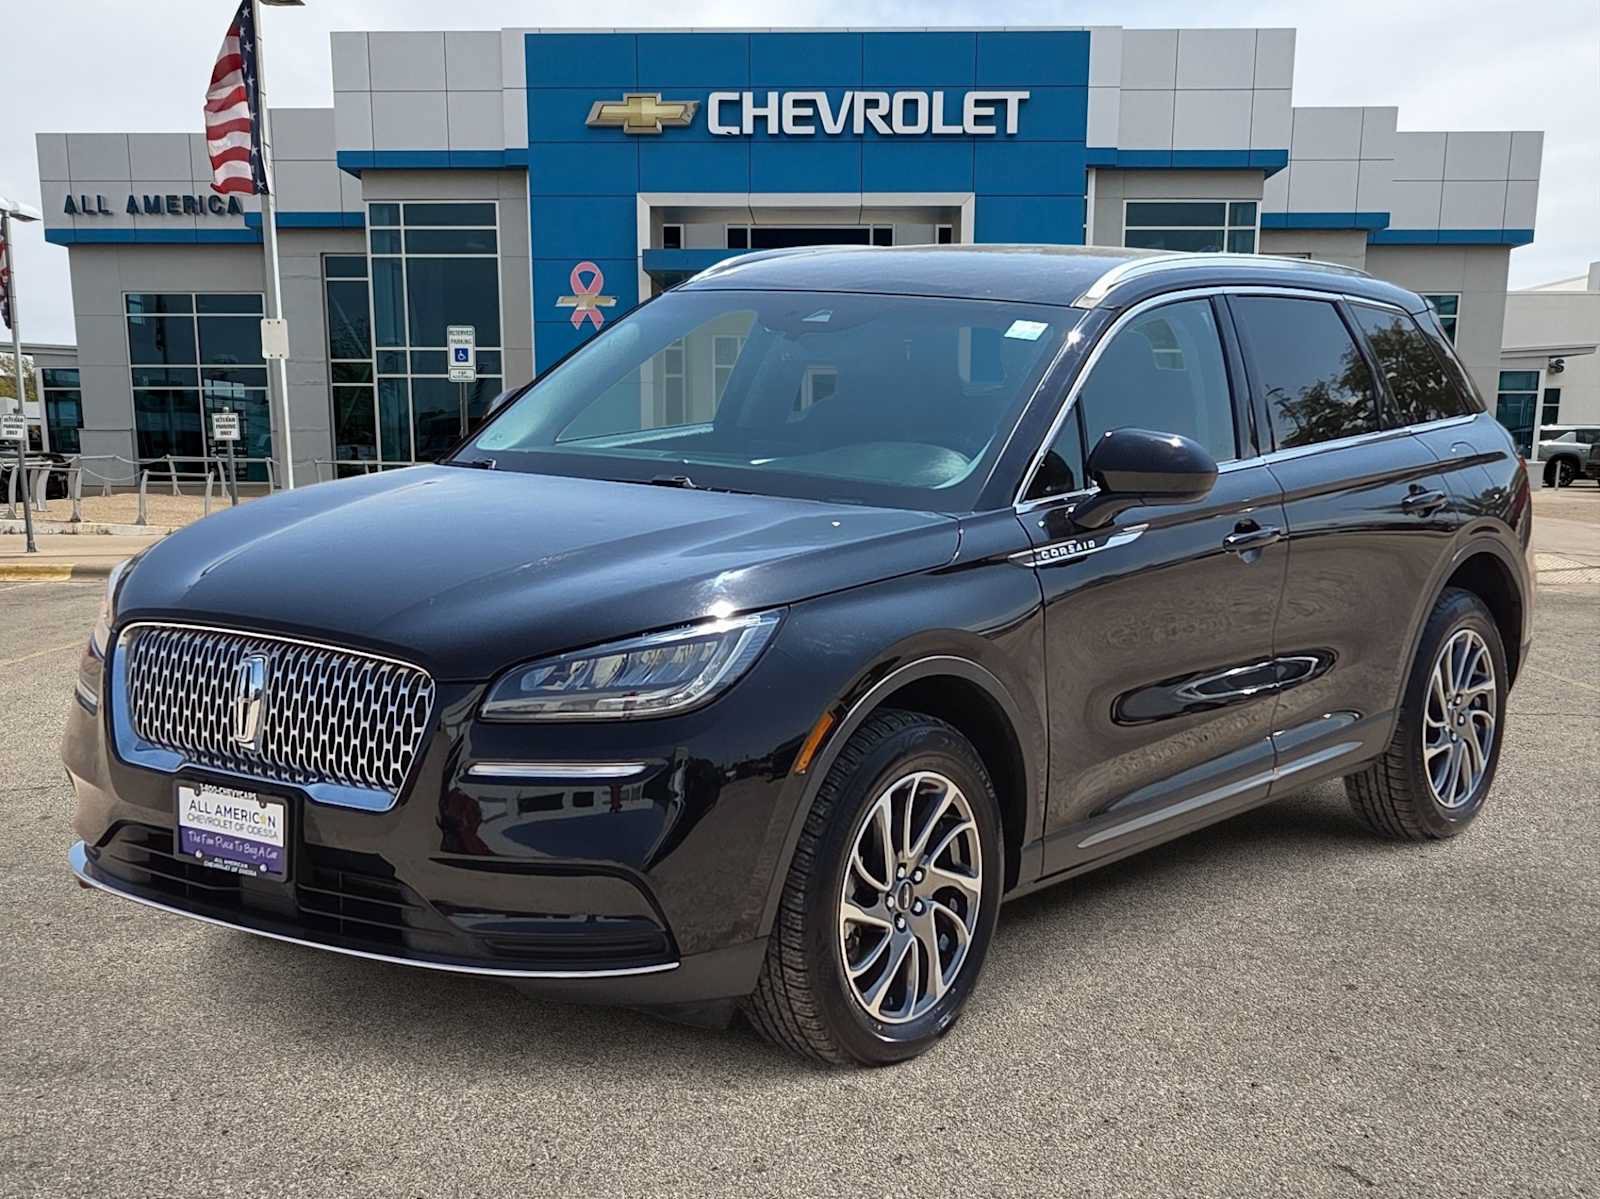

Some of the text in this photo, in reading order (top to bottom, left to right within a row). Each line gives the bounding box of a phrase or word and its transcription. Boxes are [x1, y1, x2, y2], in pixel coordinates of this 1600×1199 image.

[707, 91, 1030, 135] CHEVROLET
[64, 194, 112, 215] ALL
[1041, 540, 1096, 559] CORSAIR
[189, 800, 211, 814] ALL
[187, 812, 279, 840] CHEVROLET OF ODESSA
[234, 841, 243, 851] To
[243, 843, 257, 859] Buy
[258, 849, 265, 858] A
